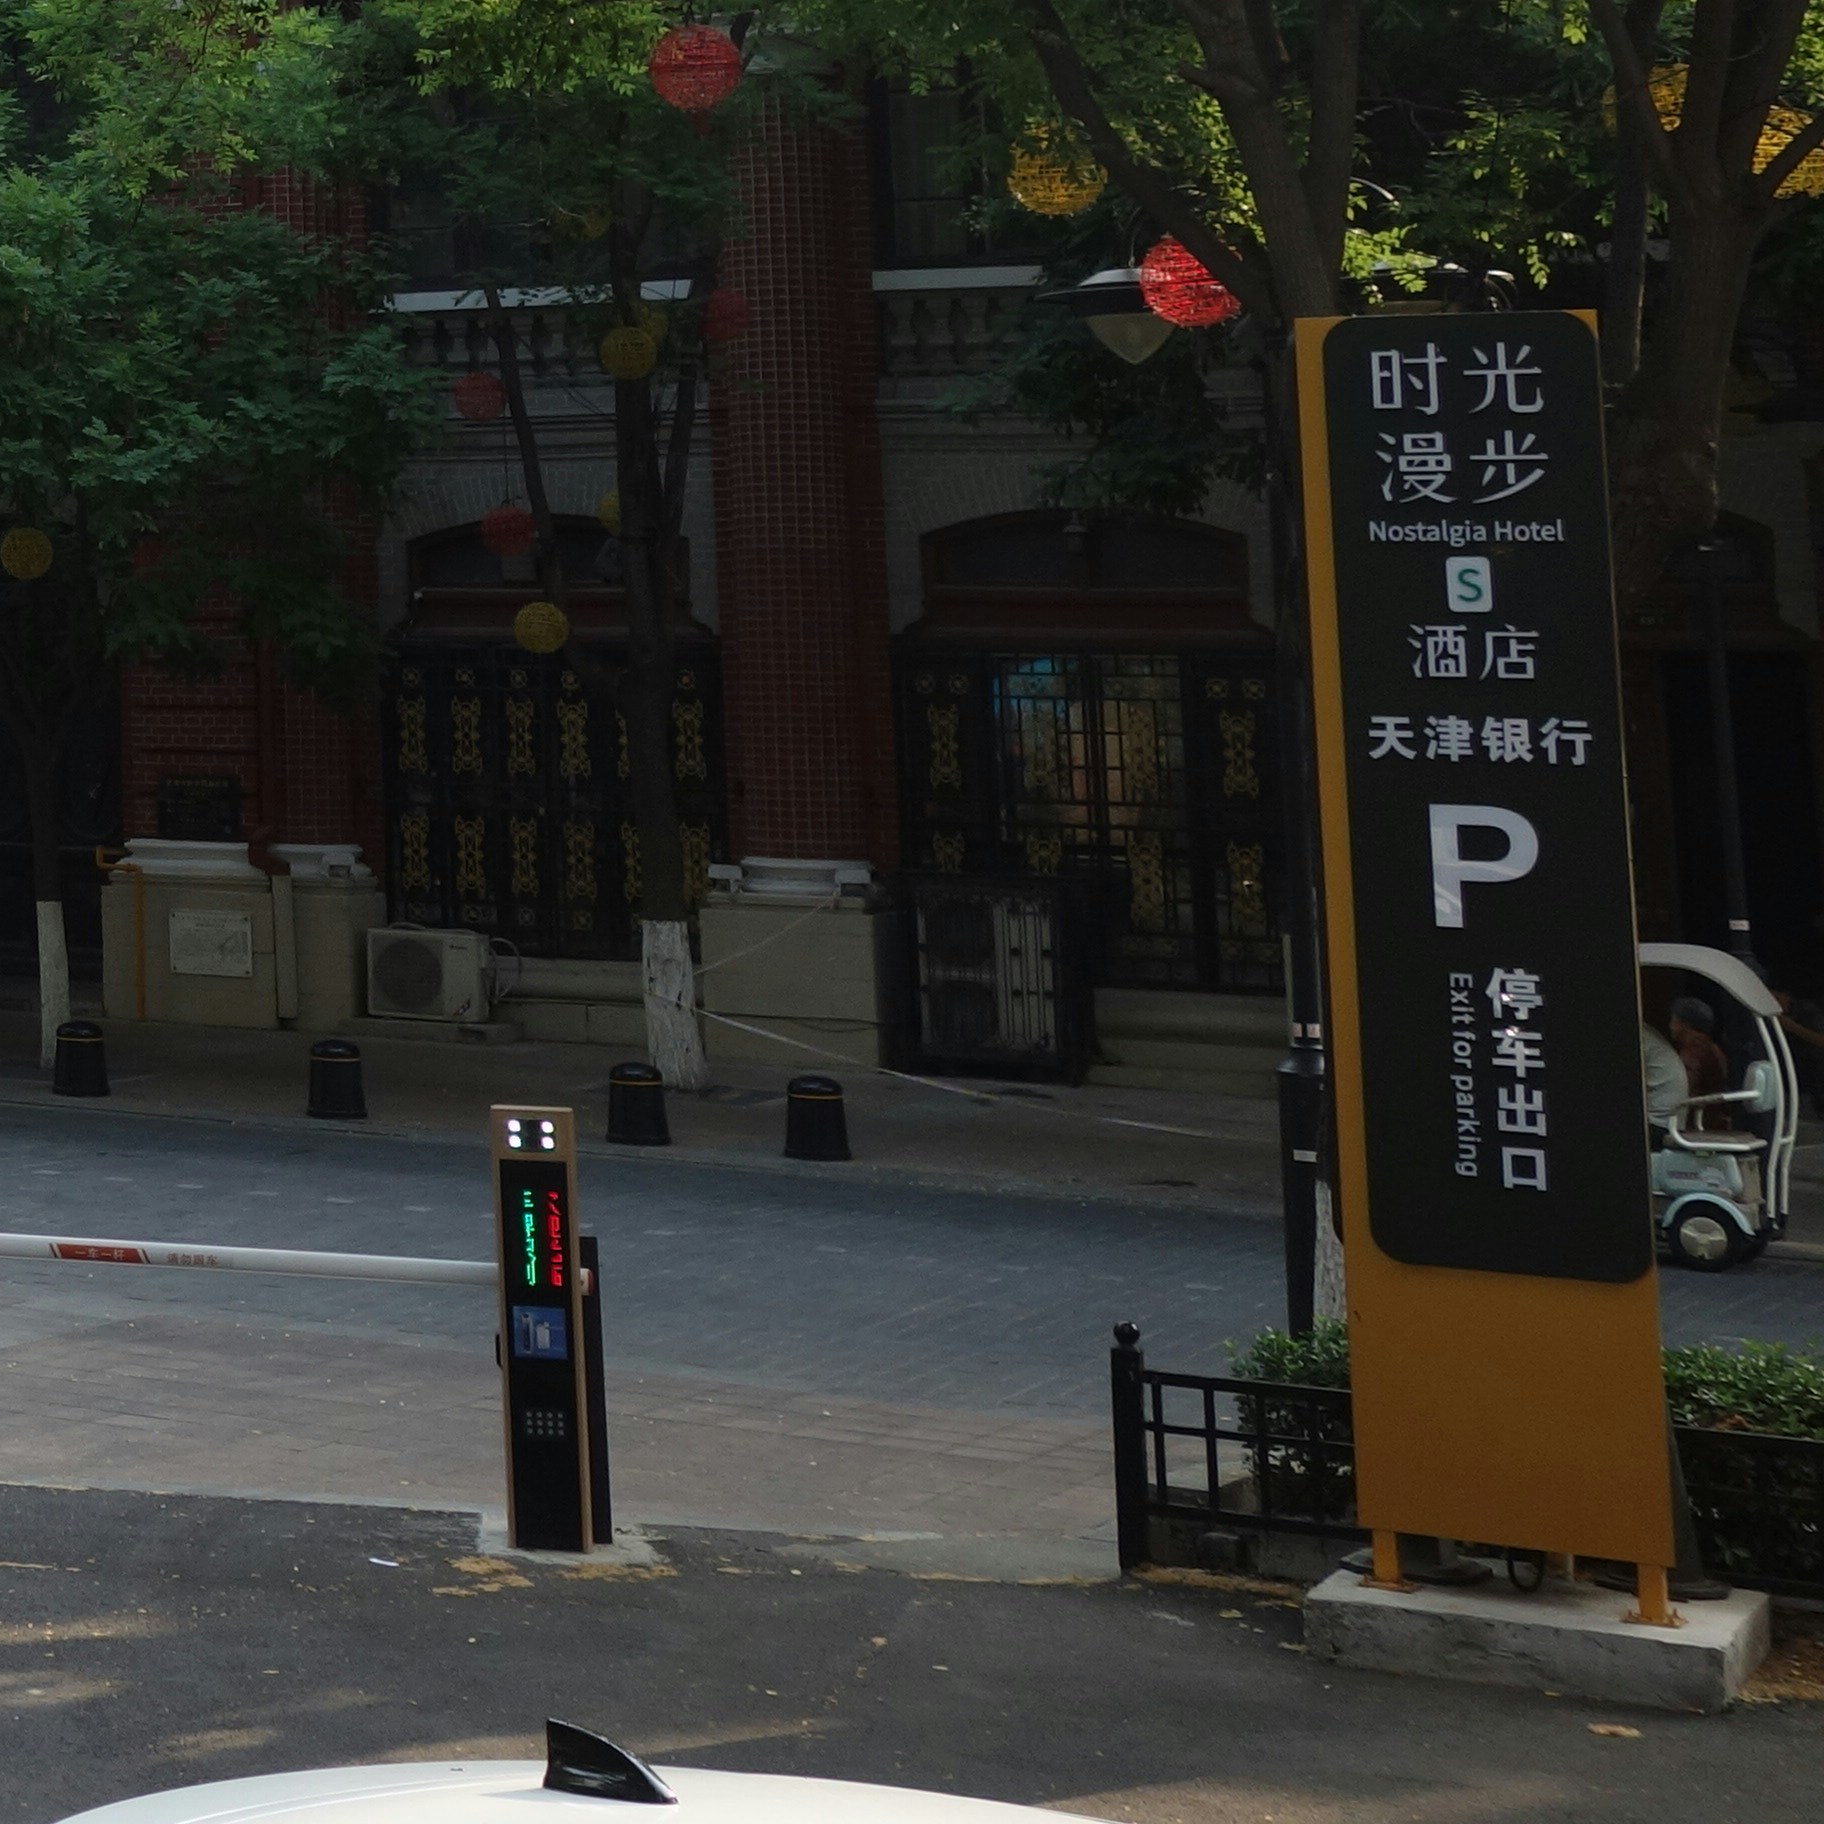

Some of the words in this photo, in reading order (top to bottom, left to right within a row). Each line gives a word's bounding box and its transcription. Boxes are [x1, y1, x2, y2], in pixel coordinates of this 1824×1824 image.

[1369, 342, 1545, 416] 时光
[1375, 429, 1550, 504] 漫步
[1368, 519, 1487, 548] Nostalgia
[1494, 518, 1565, 543] Hotel
[1456, 567, 1483, 603] S
[1406, 623, 1541, 682] 酒店
[1367, 715, 1594, 766] 天津银行
[1427, 803, 1540, 929] P
[1449, 972, 1472, 1023] Exit
[1451, 1027, 1478, 1069] for
[1485, 966, 1549, 1193] 停车出口
[1450, 1074, 1482, 1178] parking
